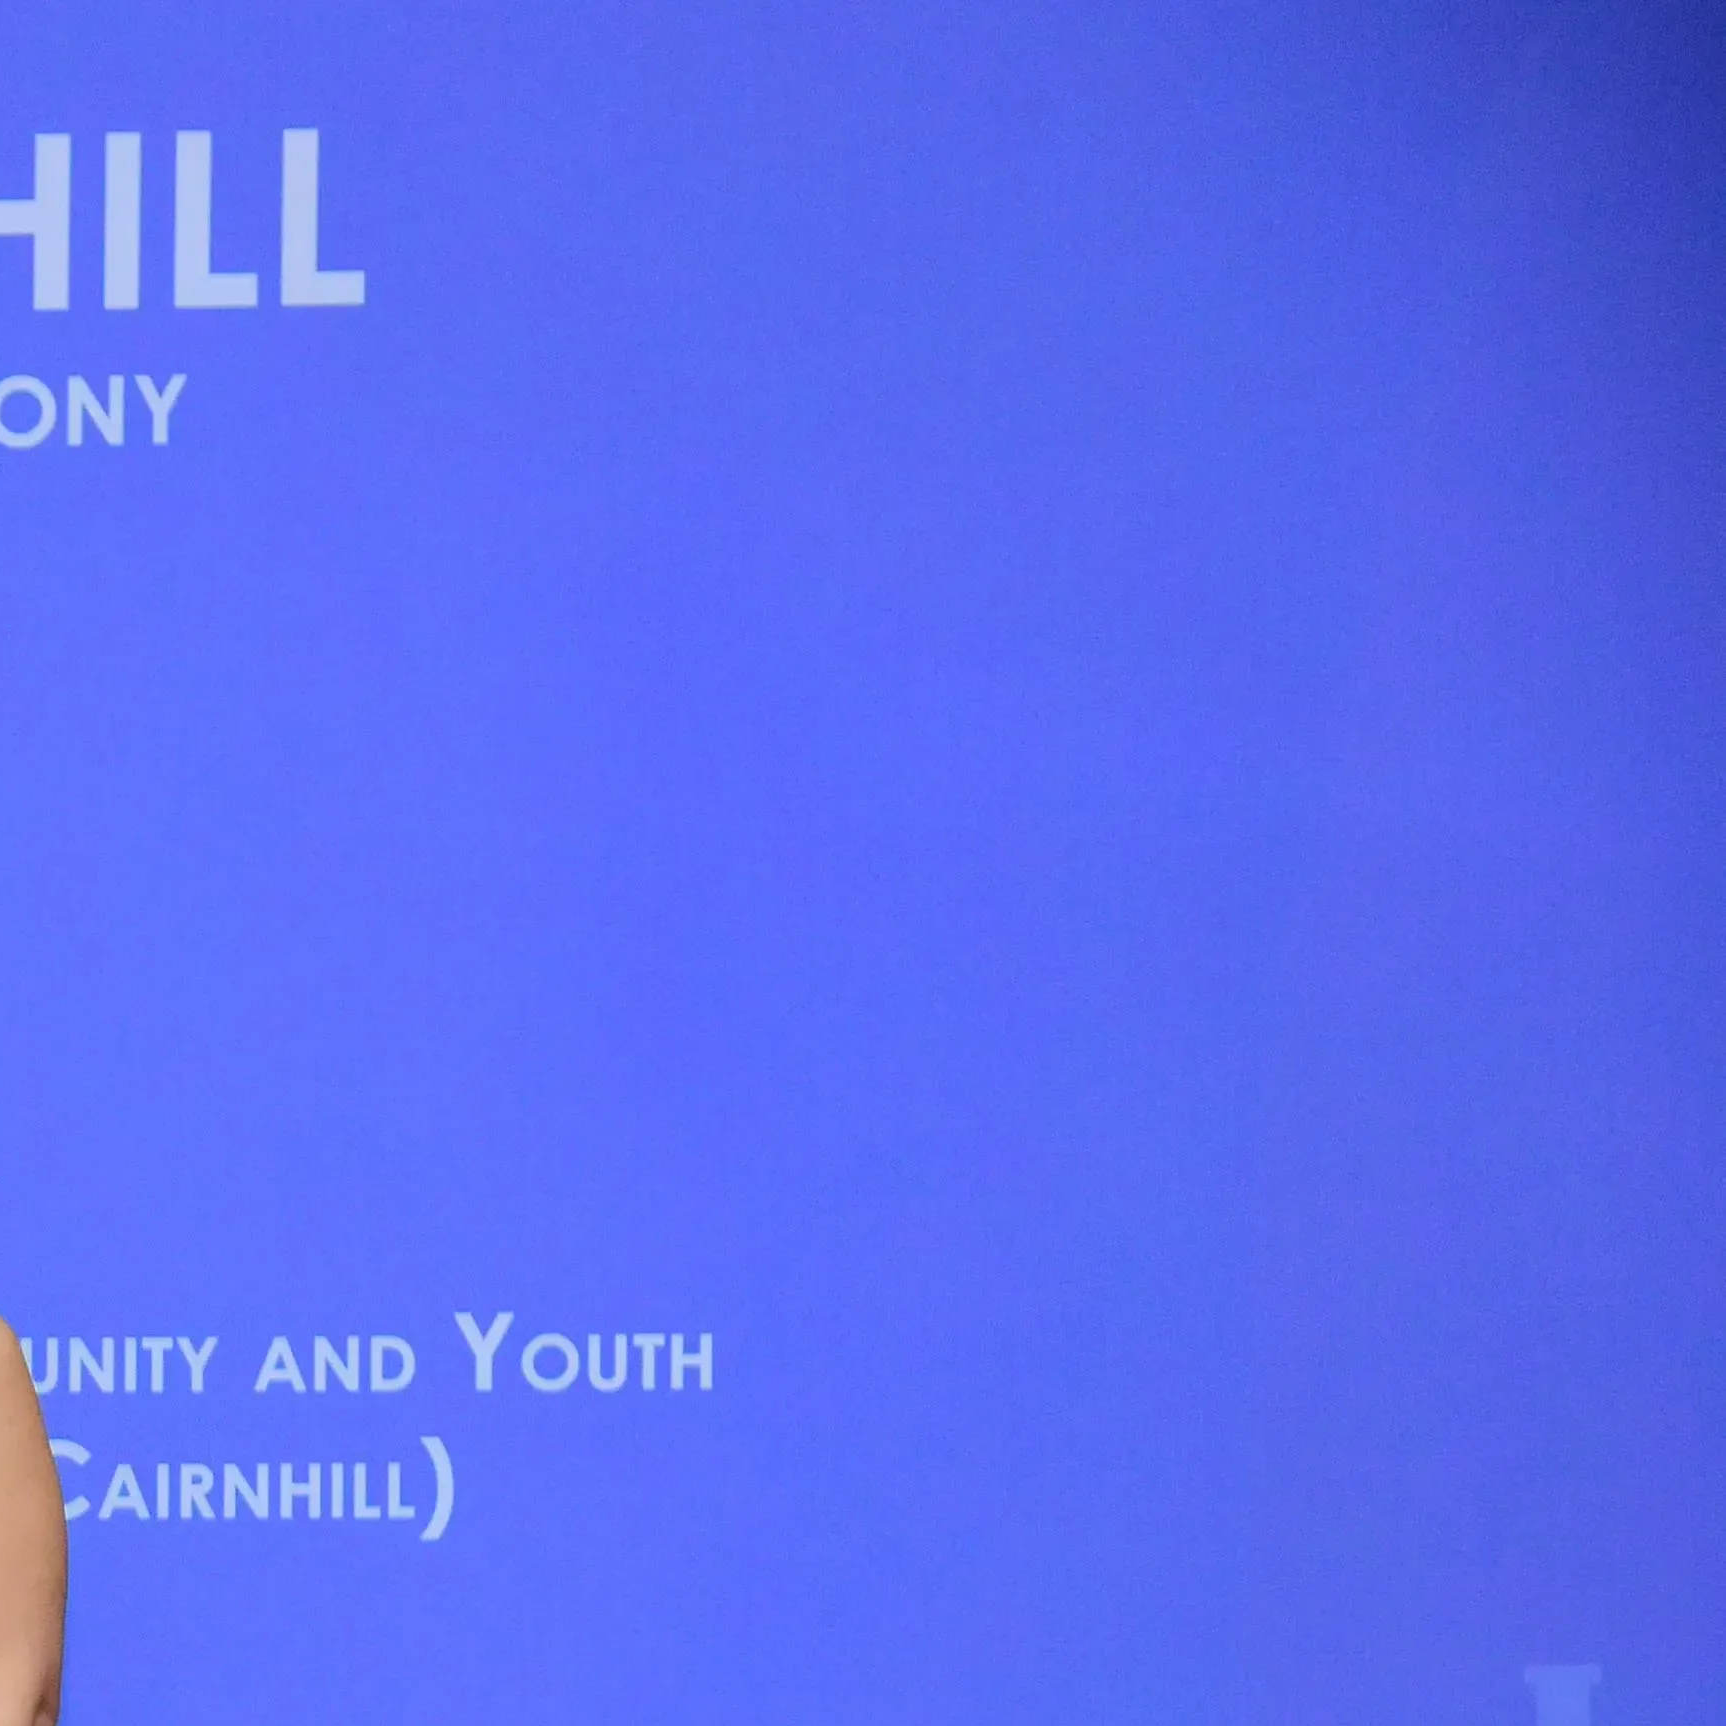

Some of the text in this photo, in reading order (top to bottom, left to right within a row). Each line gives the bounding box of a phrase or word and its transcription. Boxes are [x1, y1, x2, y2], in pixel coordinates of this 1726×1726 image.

[20, 1336, 219, 1395] UNITY
[253, 1335, 417, 1394] AND
[454, 1311, 714, 1393] YOUTH
